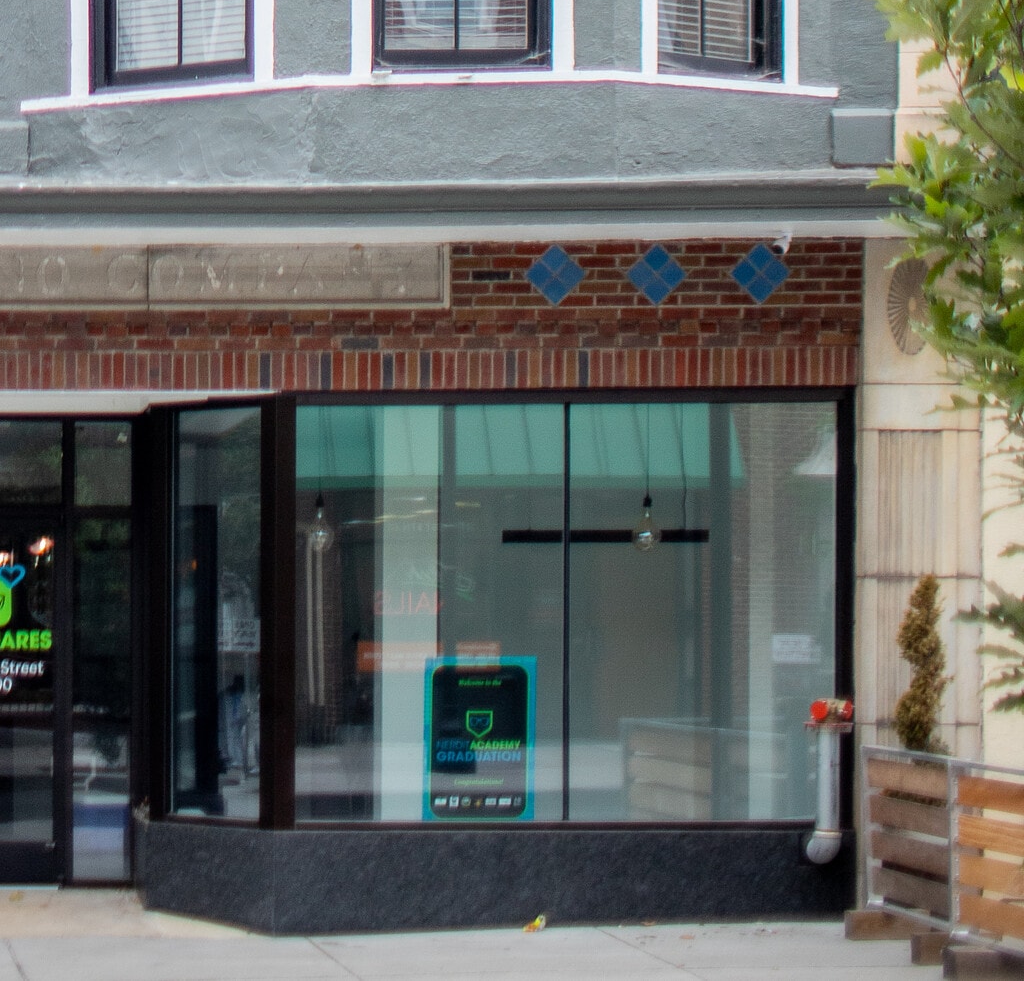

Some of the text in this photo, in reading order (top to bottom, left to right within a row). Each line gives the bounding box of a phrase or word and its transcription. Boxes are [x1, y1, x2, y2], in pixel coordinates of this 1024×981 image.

[0, 658, 45, 676] Street
[470, 739, 521, 751] ACADEMY
[436, 751, 522, 762] GRADUATION
